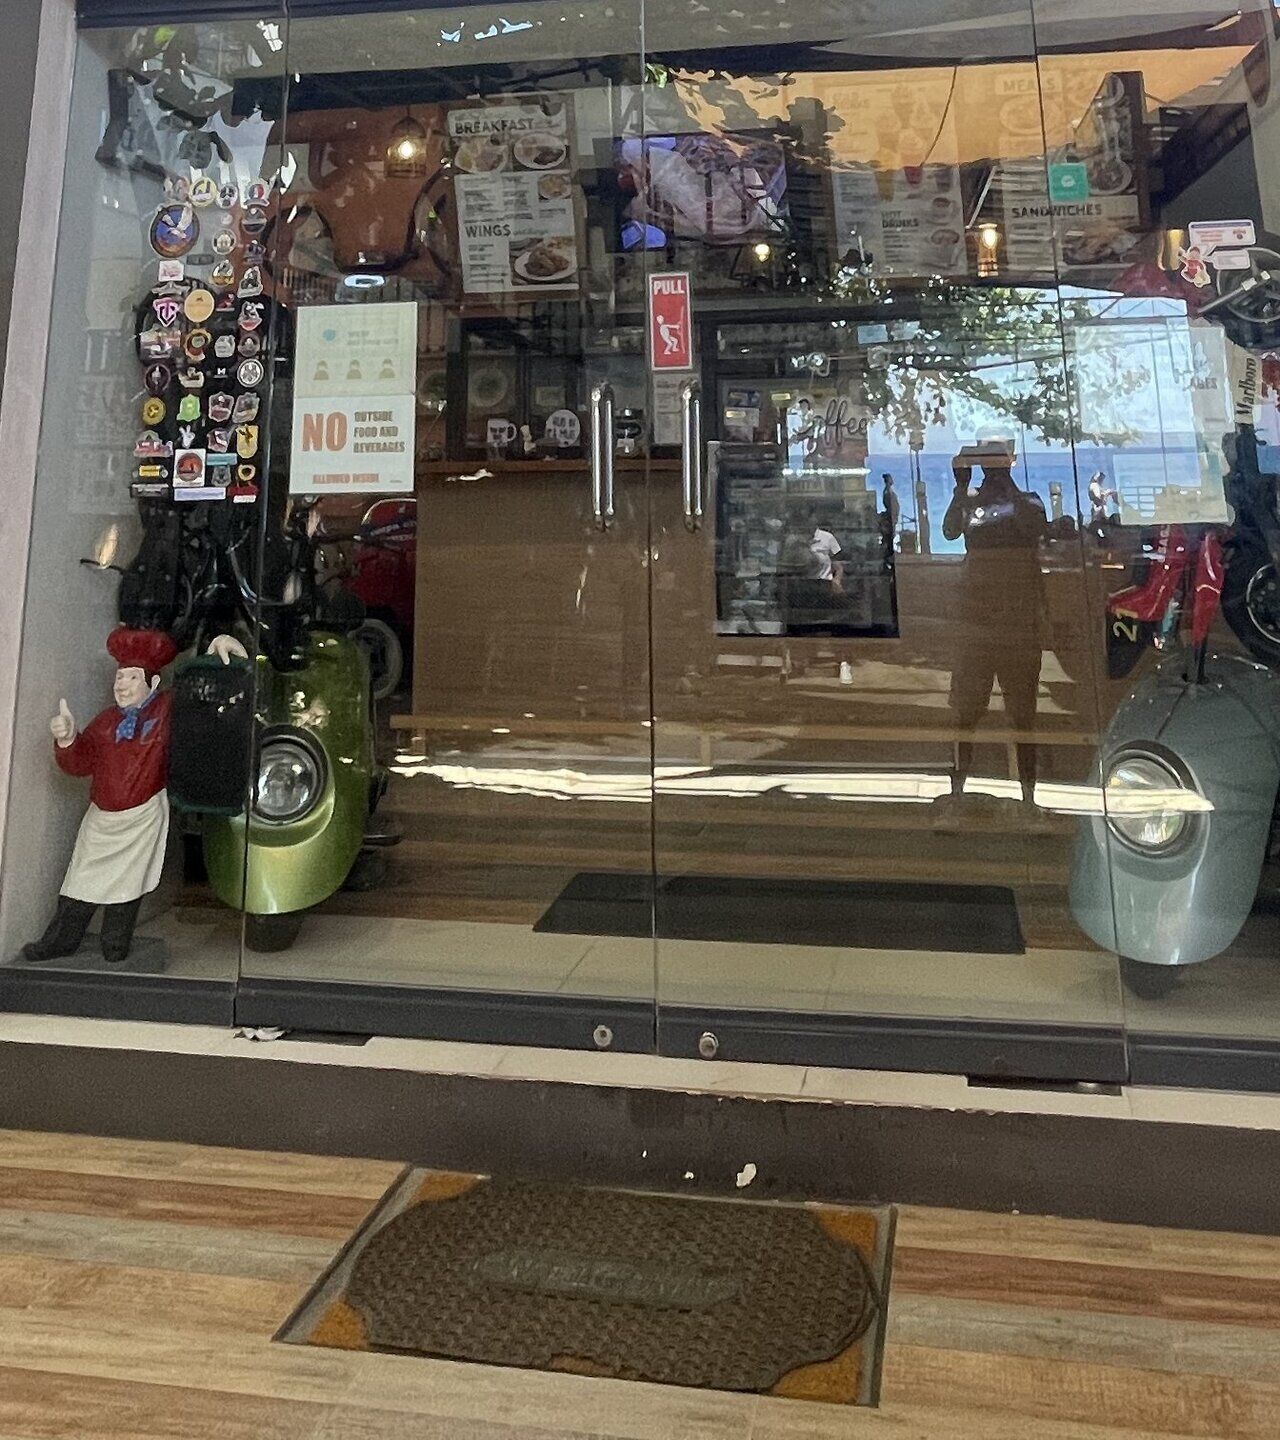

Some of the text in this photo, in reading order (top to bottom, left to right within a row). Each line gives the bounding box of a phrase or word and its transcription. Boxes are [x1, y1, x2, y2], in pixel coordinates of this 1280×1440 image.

[455, 117, 534, 135] BREAKFAST
[1011, 203, 1103, 219] SANDWICHES
[465, 223, 512, 239] WINGS
[653, 279, 686, 296] PULL
[1235, 357, 1257, 417] Marlboro
[354, 410, 394, 423] OUTSIDE
[301, 411, 348, 453] NO
[353, 425, 399, 439] FOOD AND
[353, 441, 406, 454] BEVERAGES
